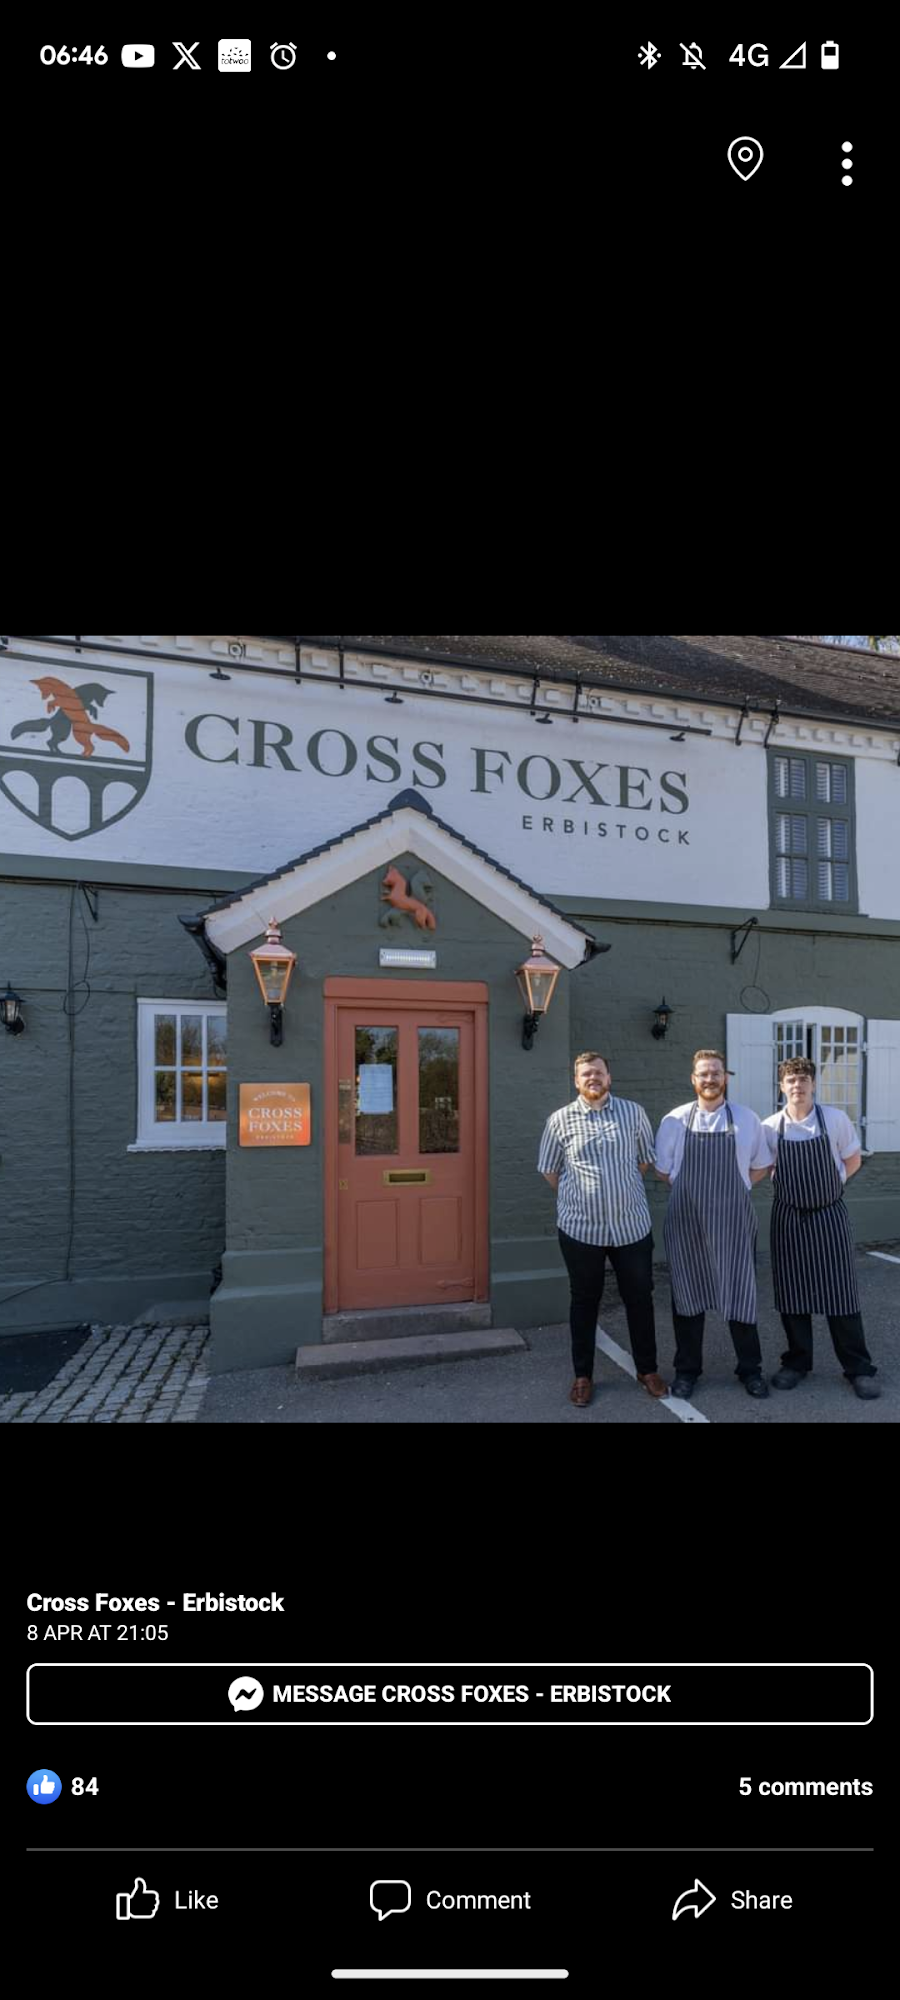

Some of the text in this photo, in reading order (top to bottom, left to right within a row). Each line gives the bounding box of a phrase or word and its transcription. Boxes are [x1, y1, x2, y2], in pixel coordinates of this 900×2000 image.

[184, 713, 690, 815] CROSS FOXES
[522, 815, 691, 846] ERBISTOCK
[248, 1107, 302, 1120] CROSS
[249, 1121, 303, 1133] FOXES
